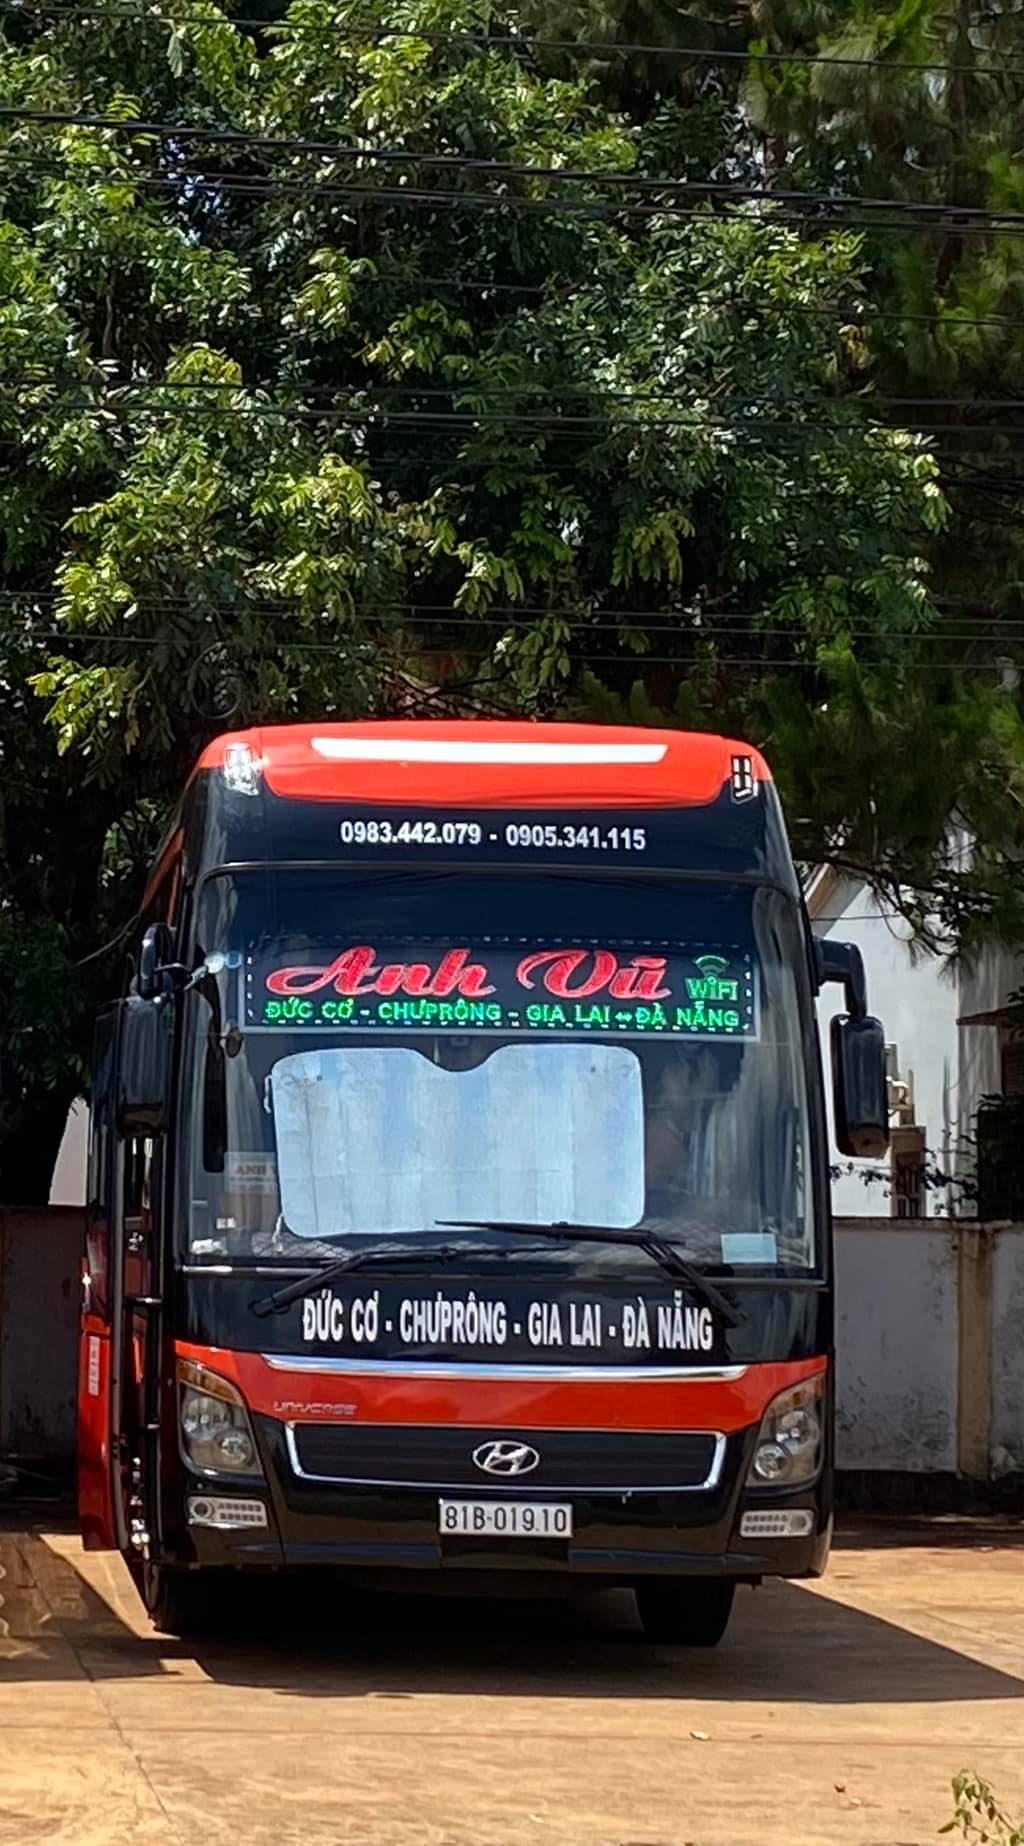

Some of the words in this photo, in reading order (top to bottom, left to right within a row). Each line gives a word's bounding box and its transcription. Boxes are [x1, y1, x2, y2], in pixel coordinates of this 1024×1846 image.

[340, 820, 481, 844] 0983.442.079
[506, 824, 646, 850] 0905.341.115
[266, 946, 496, 996] Anh
[516, 949, 672, 999] Vũ
[266, 997, 313, 1019] ĐỨC
[527, 1004, 565, 1023] GIA
[576, 1004, 610, 1023] LAI
[635, 1003, 666, 1025] ĐÀ
[303, 1289, 343, 1341] ĐỨC
[399, 1290, 507, 1345] CHƯPRÔNG
[528, 1302, 563, 1346] GIA
[570, 1302, 601, 1347] LAI
[622, 1296, 650, 1348] ĐÀ
[657, 1289, 712, 1350] NẴNG
[445, 1505, 567, 1532] 81B-019.10
